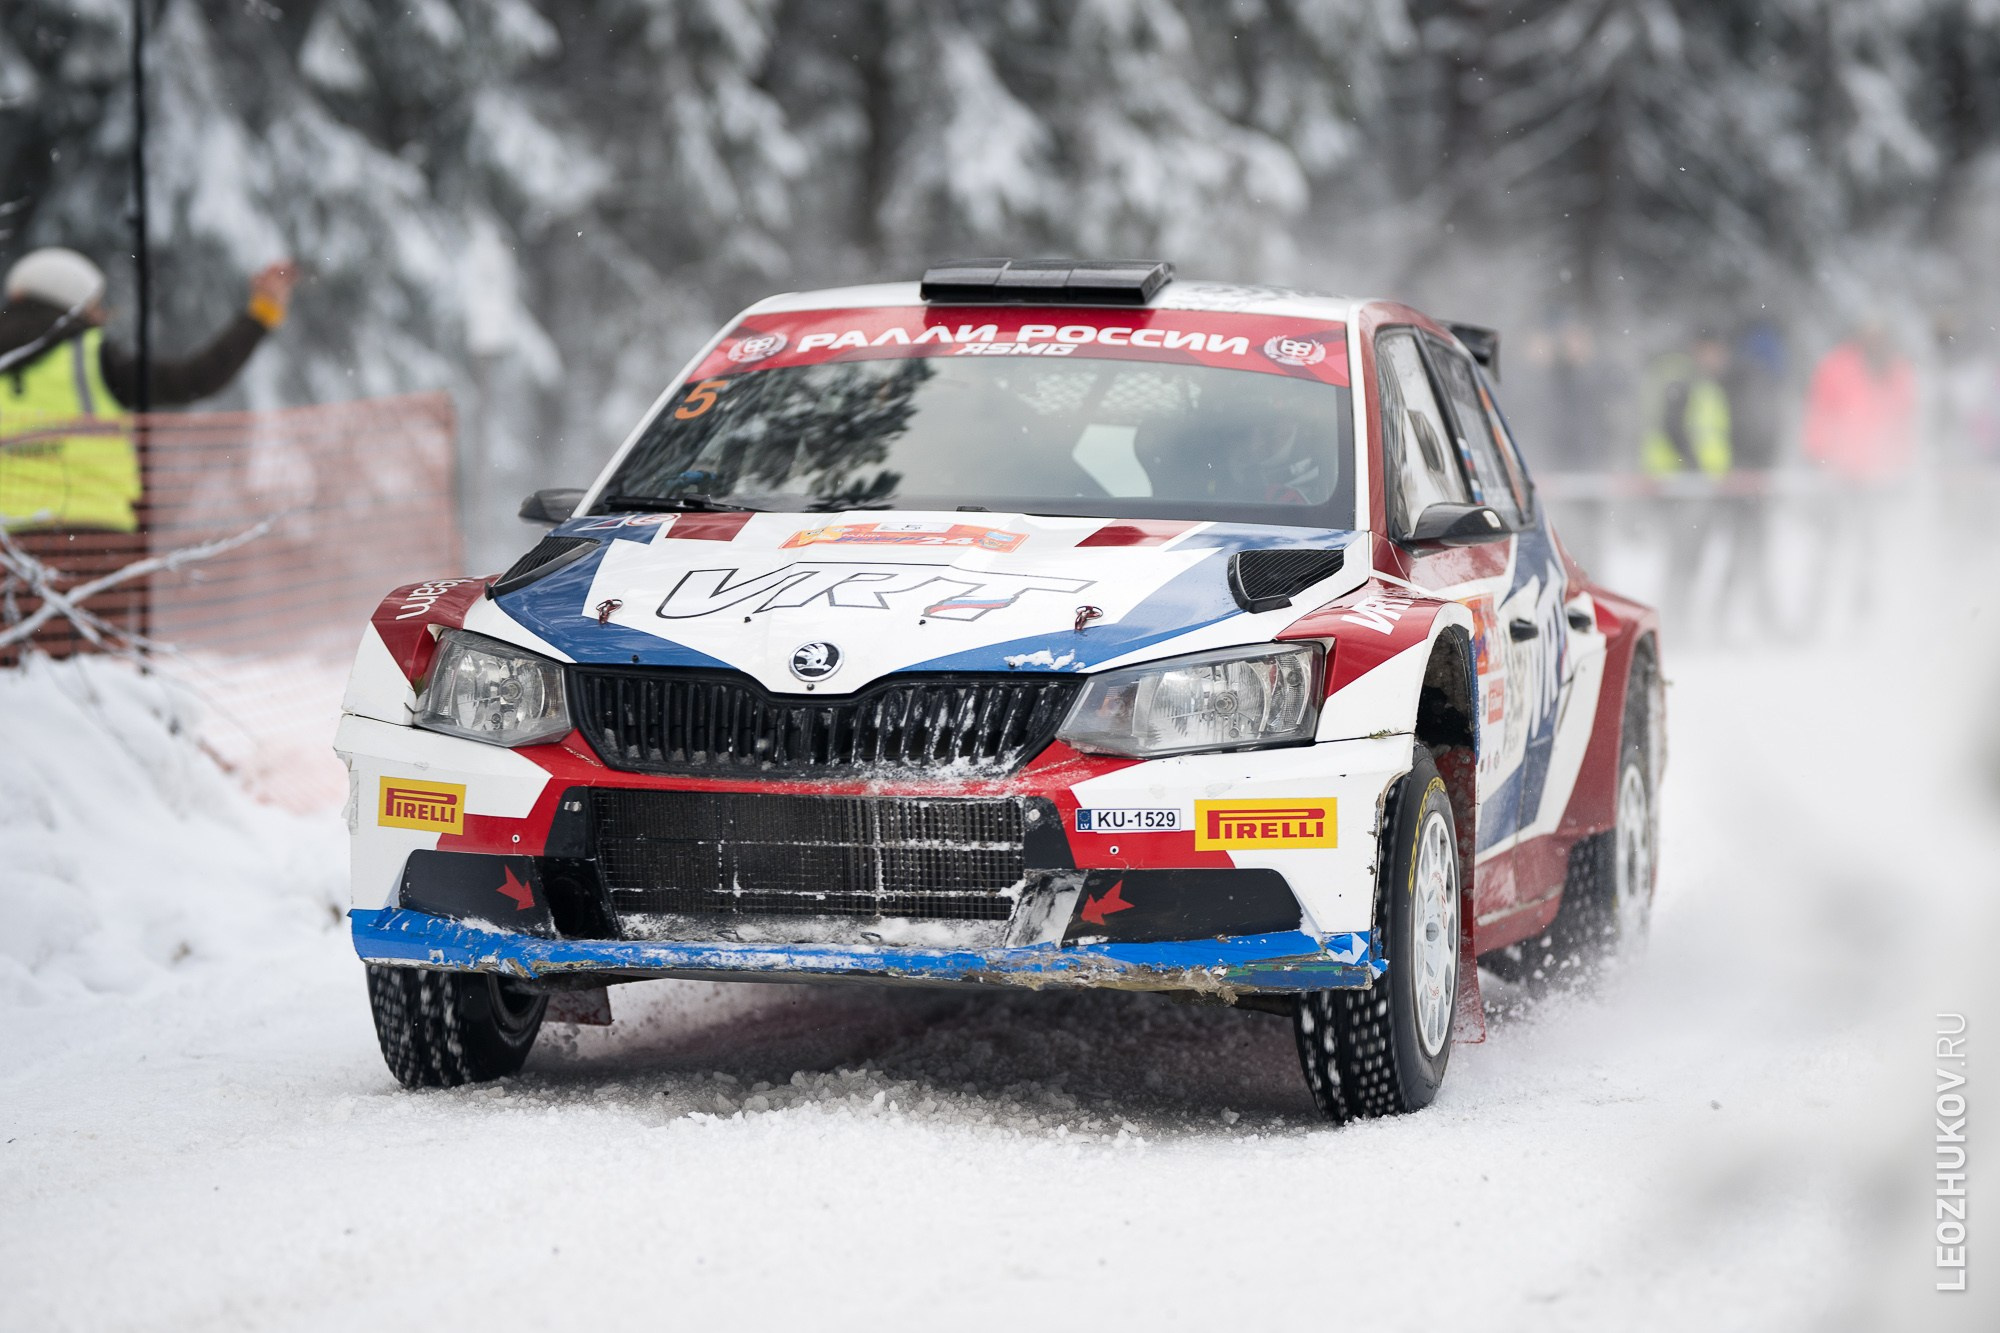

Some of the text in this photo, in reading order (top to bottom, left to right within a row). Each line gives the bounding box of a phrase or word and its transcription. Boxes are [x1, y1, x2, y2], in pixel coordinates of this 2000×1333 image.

[796, 324, 999, 353] РАЛЛИ
[1016, 324, 1250, 356] РОССИИ
[674, 380, 729, 420] 5
[915, 536, 975, 545] 24
[655, 561, 1098, 621] VRT
[385, 787, 458, 824] PIRELLI
[1097, 811, 1176, 828] KU-1529
[1207, 808, 1326, 840] PIRELLI
